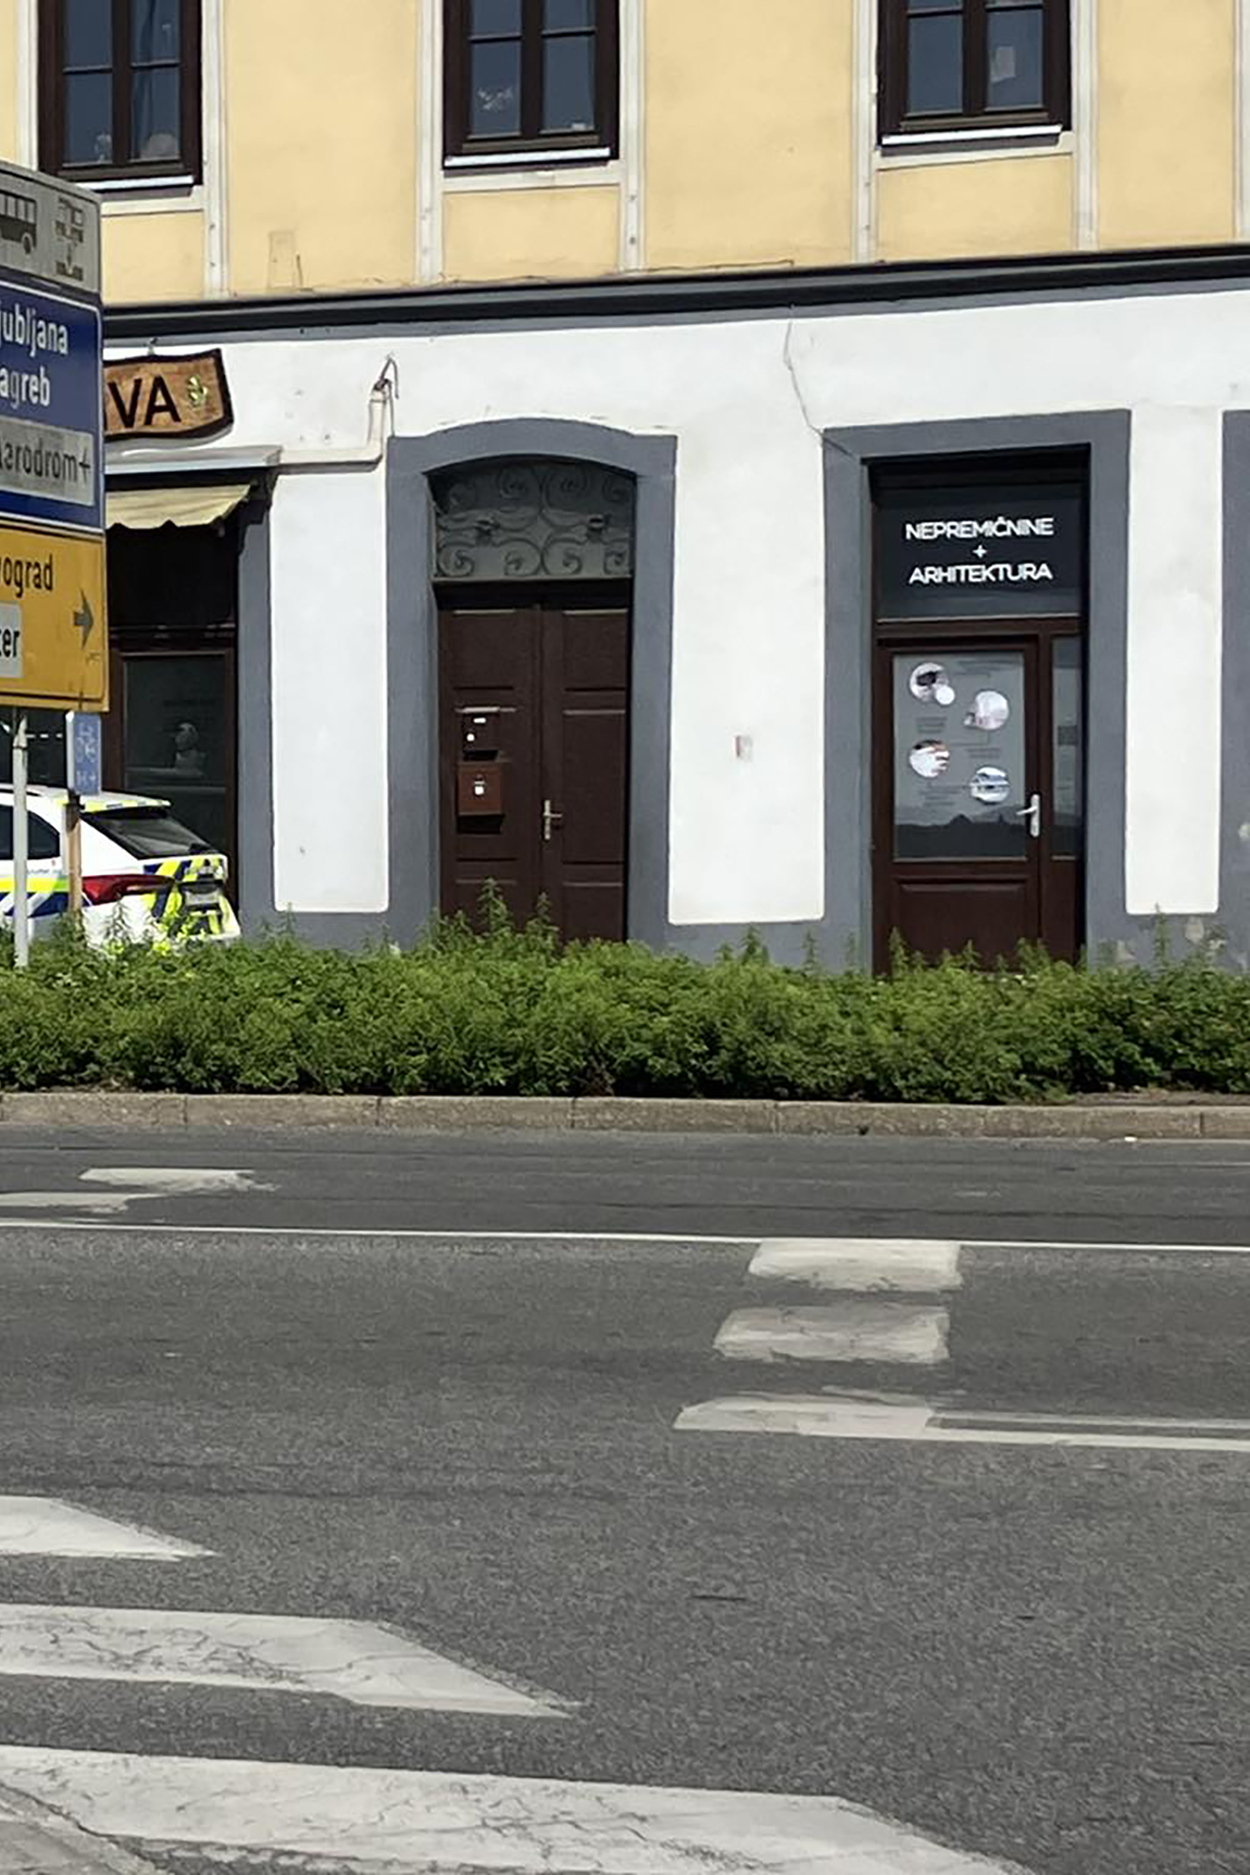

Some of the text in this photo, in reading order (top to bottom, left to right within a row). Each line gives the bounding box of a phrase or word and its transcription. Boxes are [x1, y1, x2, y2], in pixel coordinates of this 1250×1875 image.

[103, 375, 182, 431] VA
[905, 516, 1054, 540] NEPREMIČNINE
[908, 563, 1053, 584] ARHITEKTURA
